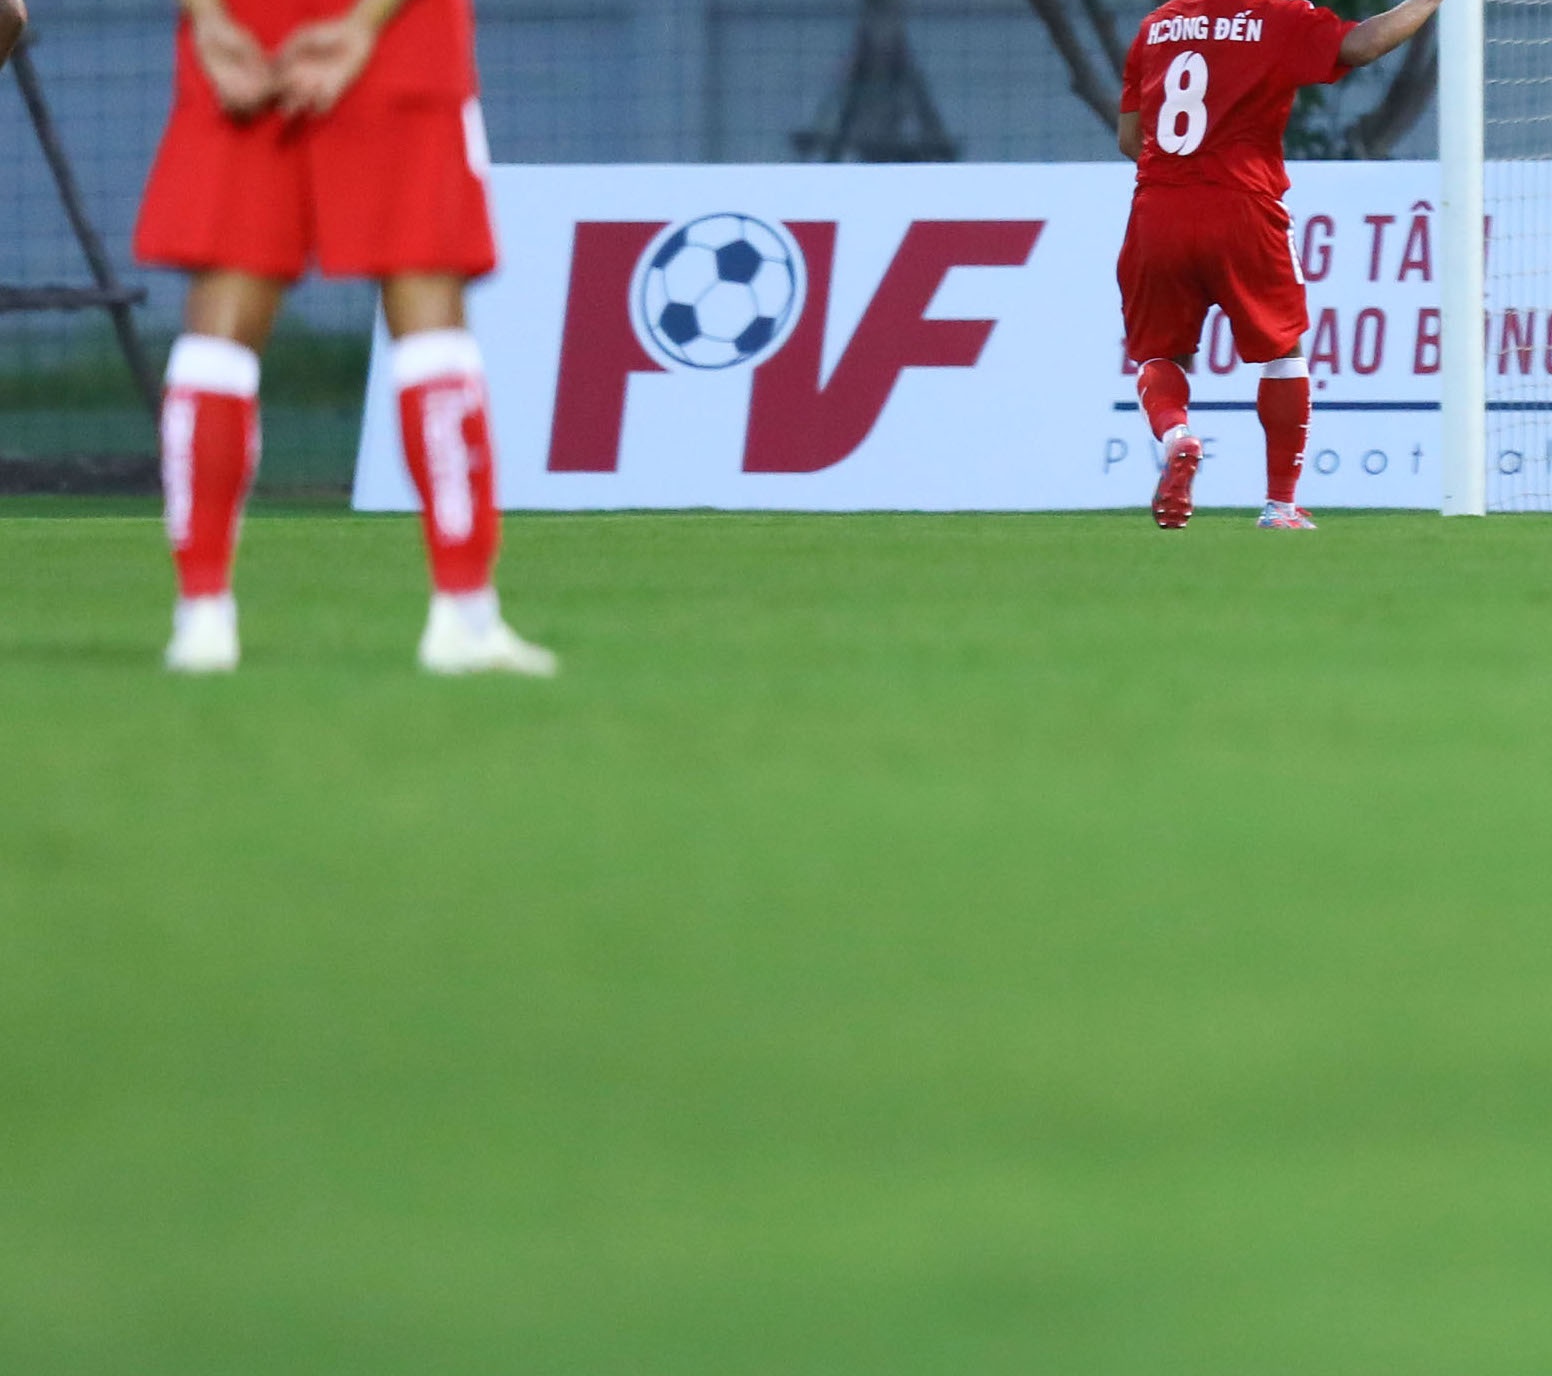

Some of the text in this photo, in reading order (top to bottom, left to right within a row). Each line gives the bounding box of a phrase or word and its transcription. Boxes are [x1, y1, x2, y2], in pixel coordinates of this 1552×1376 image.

[1213, 9, 1264, 42] ĐẾN
[1156, 50, 1209, 156] 8
[1364, 200, 1493, 282] TÂ
[546, 216, 1048, 474] PVF
